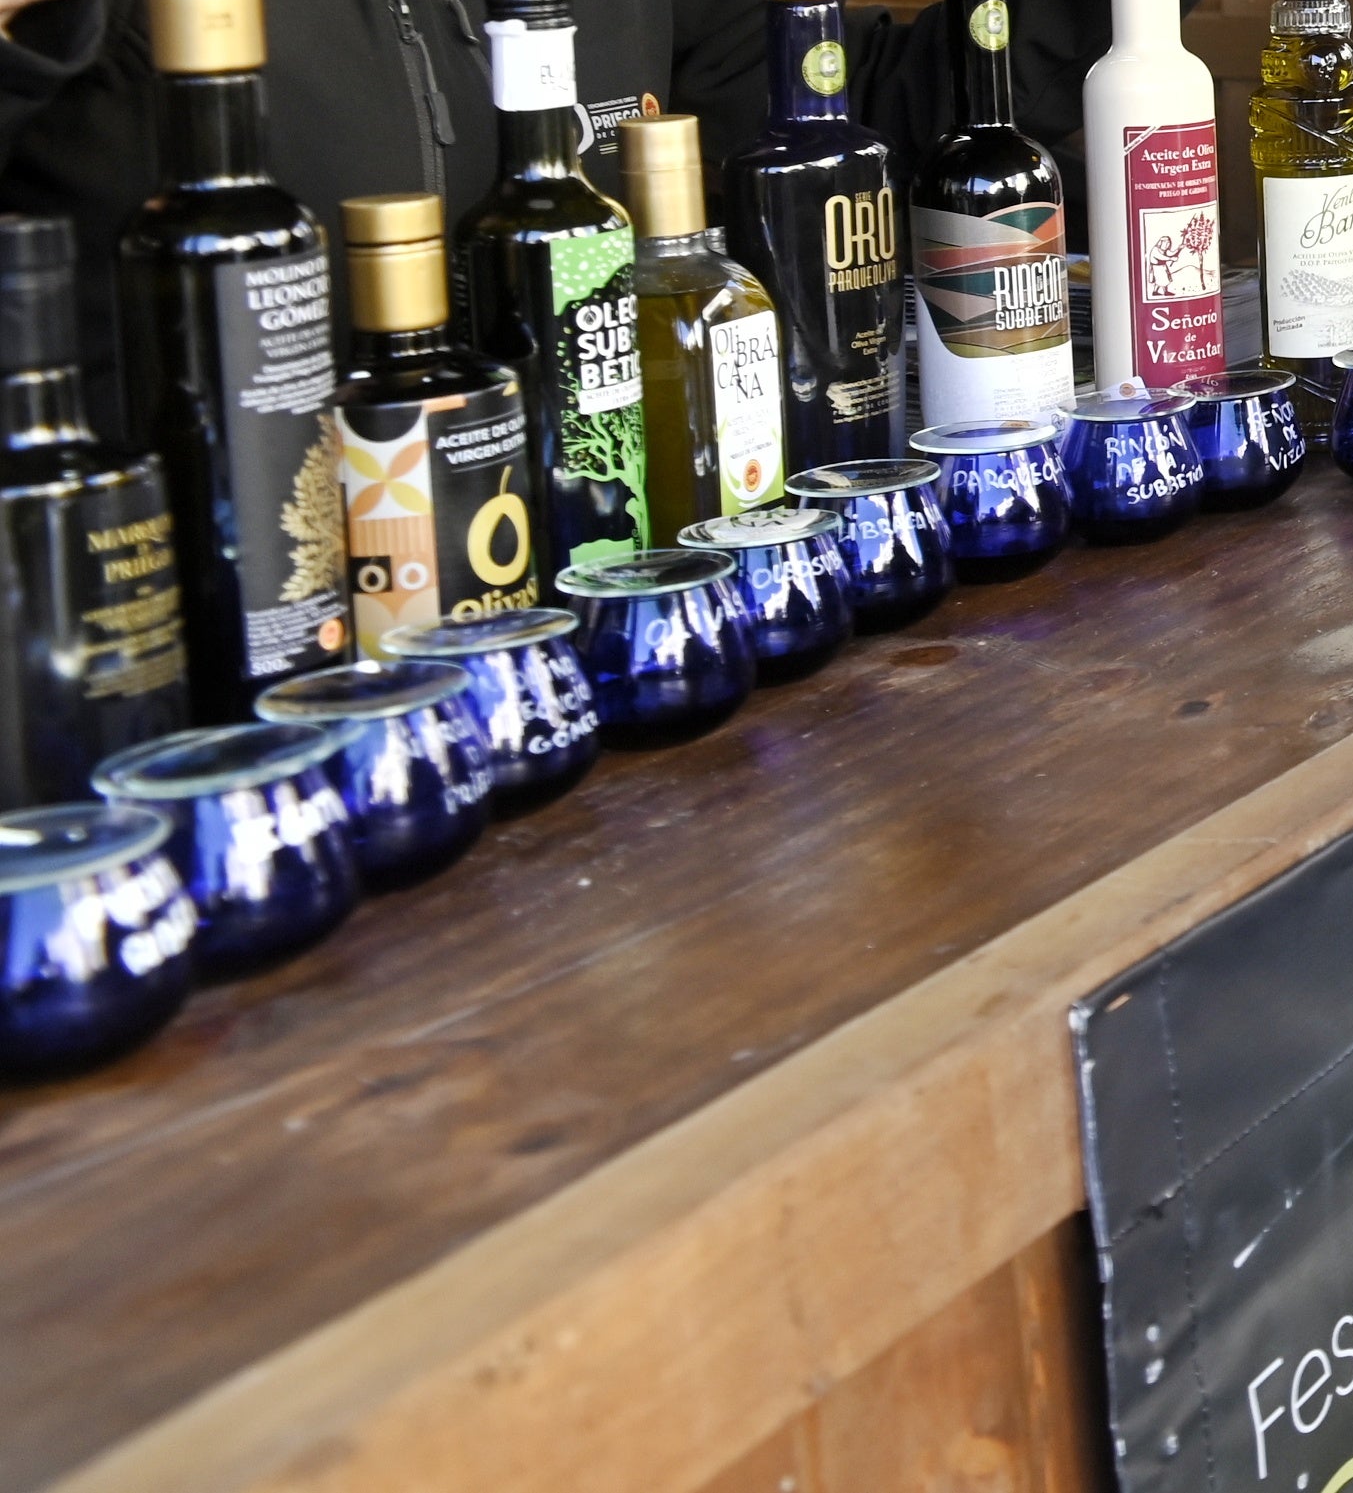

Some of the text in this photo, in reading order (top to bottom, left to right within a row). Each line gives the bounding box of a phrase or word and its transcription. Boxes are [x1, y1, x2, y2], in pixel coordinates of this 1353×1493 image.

[1141, 148, 1180, 162] Aceite
[1182, 146, 1196, 159] de
[1151, 162, 1190, 177] Virgen
[825, 187, 896, 270] ORO
[829, 260, 896, 294] PARQUEOLIVA
[993, 255, 1062, 311] RINCÓN
[576, 293, 639, 332] OLEO
[1152, 307, 1218, 332] Señorío
[1184, 333, 1197, 343] de
[1147, 340, 1222, 364] Vizcántar
[436, 427, 489, 450] ACEITE
[491, 421, 508, 437] DE
[446, 441, 502, 465] VIRGEN
